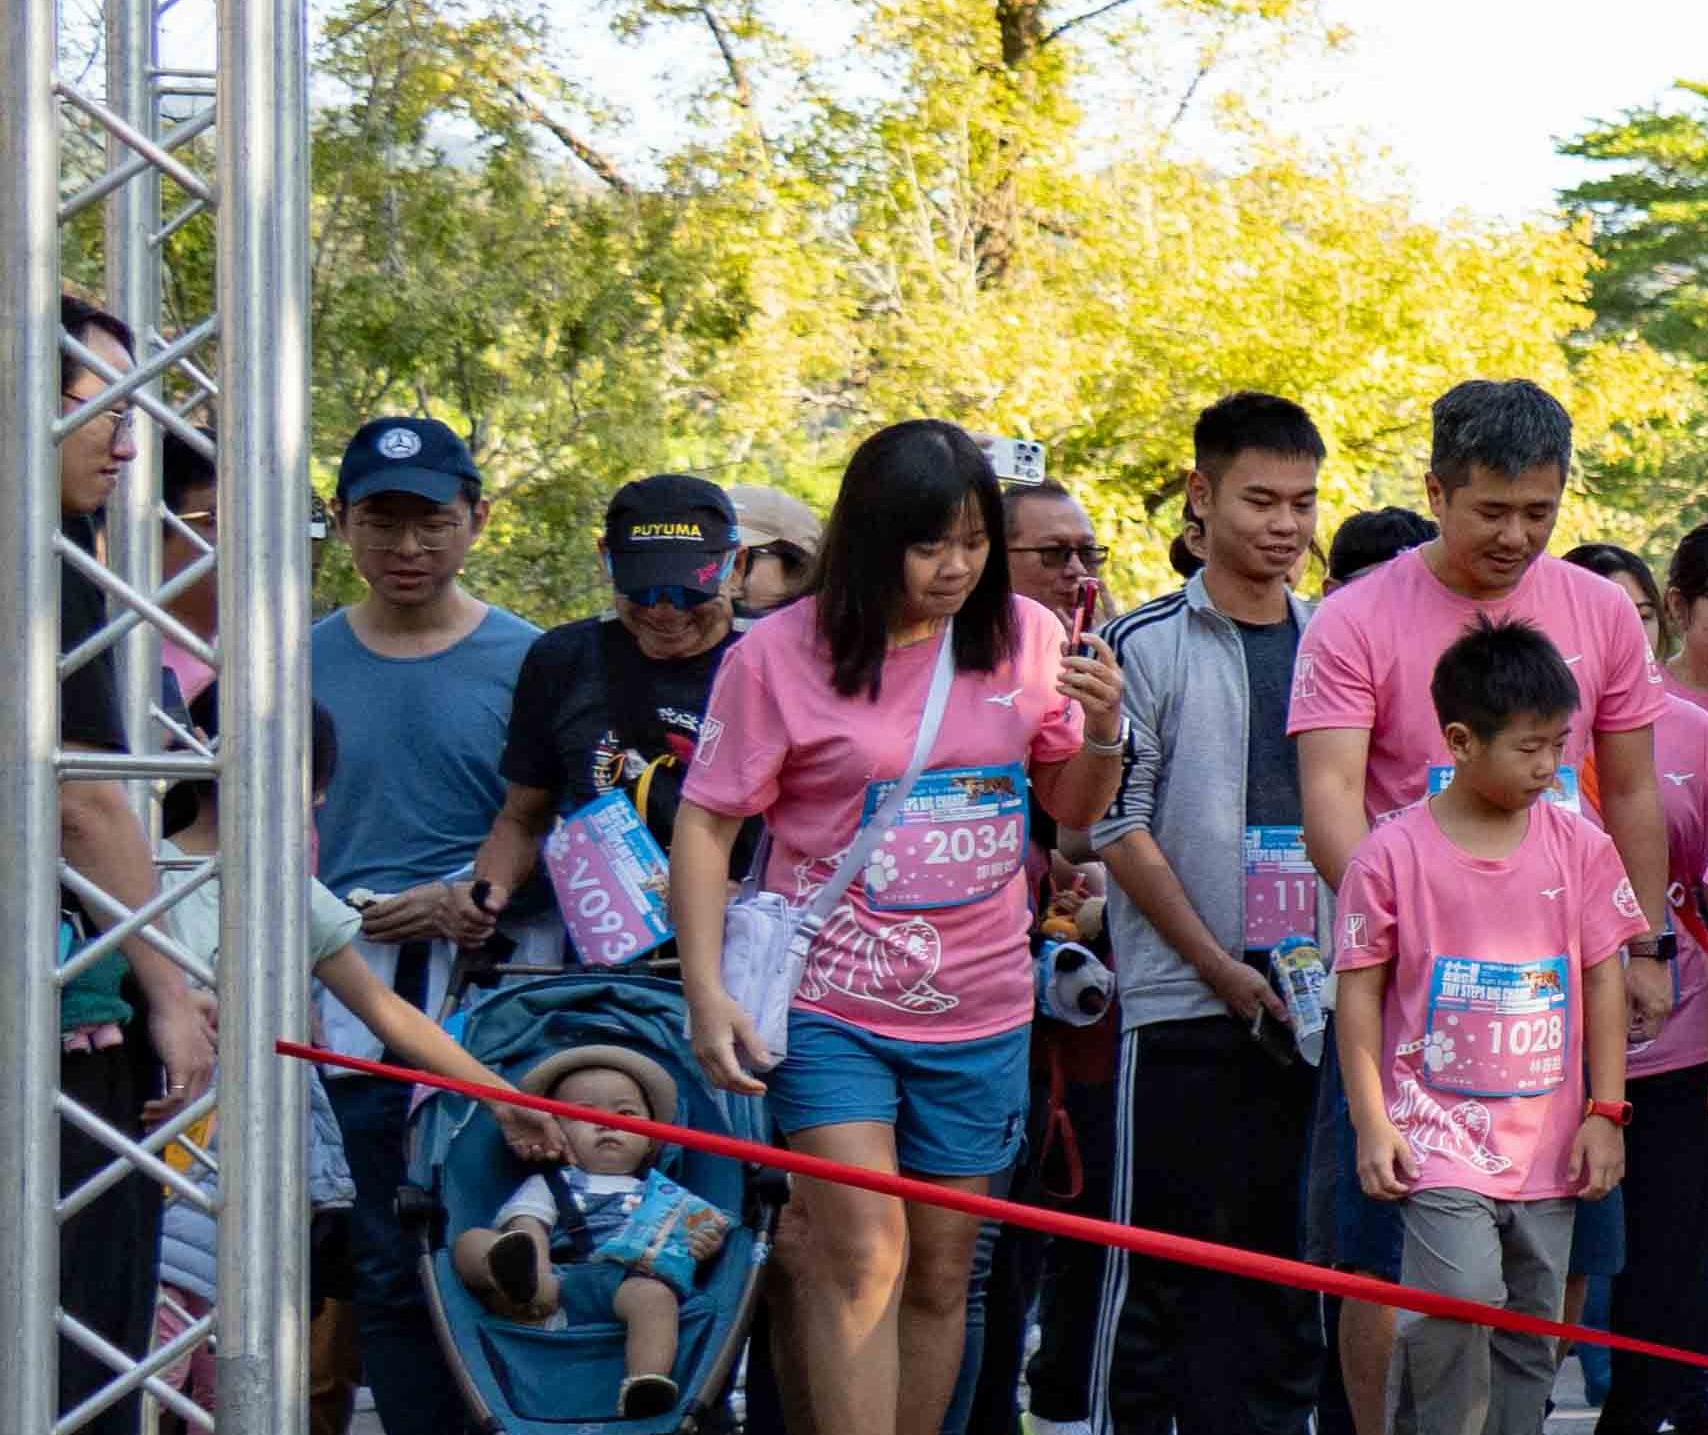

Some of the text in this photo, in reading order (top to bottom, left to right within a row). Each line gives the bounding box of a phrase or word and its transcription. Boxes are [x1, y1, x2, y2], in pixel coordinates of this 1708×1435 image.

[631, 522, 703, 538] PUYUMA
[923, 820, 1018, 864] 2034
[568, 856, 637, 961] V093
[1273, 880, 1316, 911] 11
[1488, 1014, 1563, 1056] 1028
